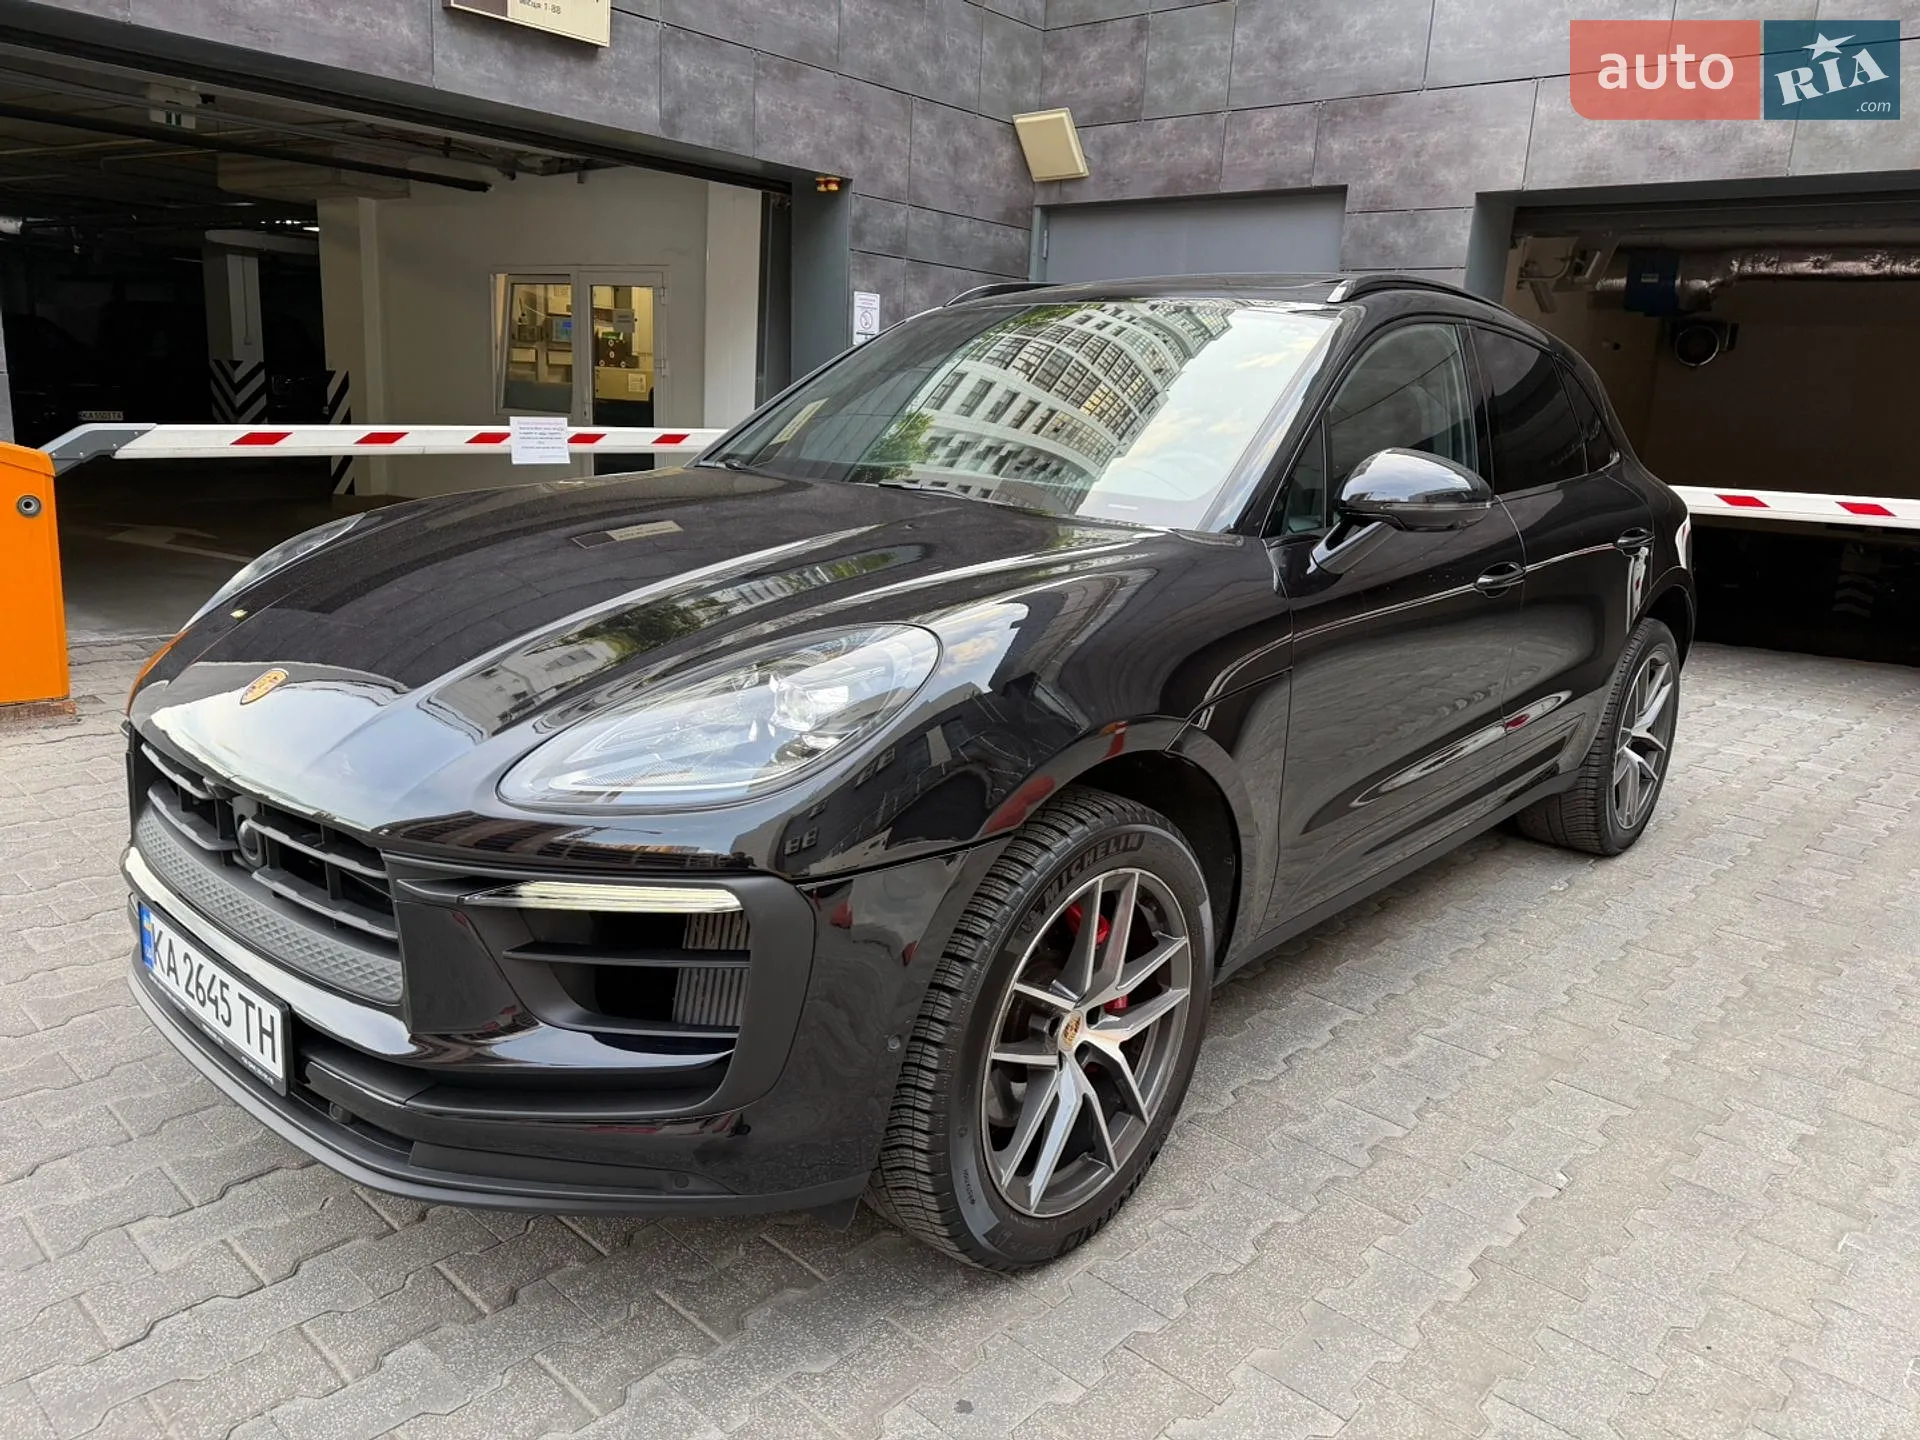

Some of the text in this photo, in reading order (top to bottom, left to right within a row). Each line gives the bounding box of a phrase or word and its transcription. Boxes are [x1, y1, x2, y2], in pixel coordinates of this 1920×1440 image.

[1041, 831, 1145, 912] MICHELIN
[151, 923, 179, 986] KA
[183, 952, 232, 1028] 2645
[238, 992, 276, 1063] TH
